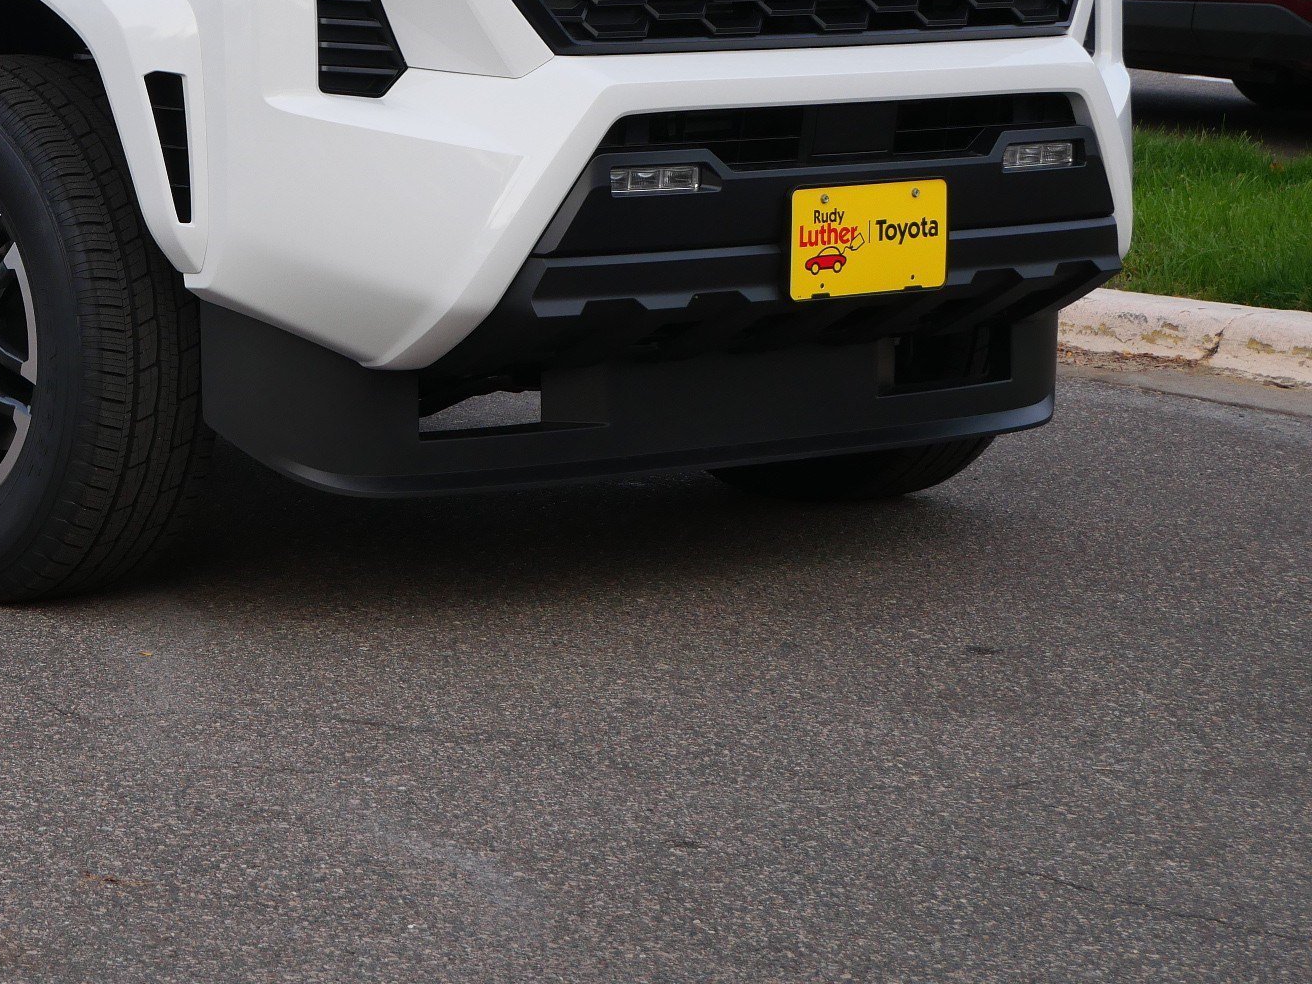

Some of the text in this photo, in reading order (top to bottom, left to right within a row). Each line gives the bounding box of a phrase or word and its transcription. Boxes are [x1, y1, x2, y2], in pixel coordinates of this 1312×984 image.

[813, 208, 845, 225] Rudy
[799, 223, 859, 248] Luther
[875, 217, 939, 245] Toyota
